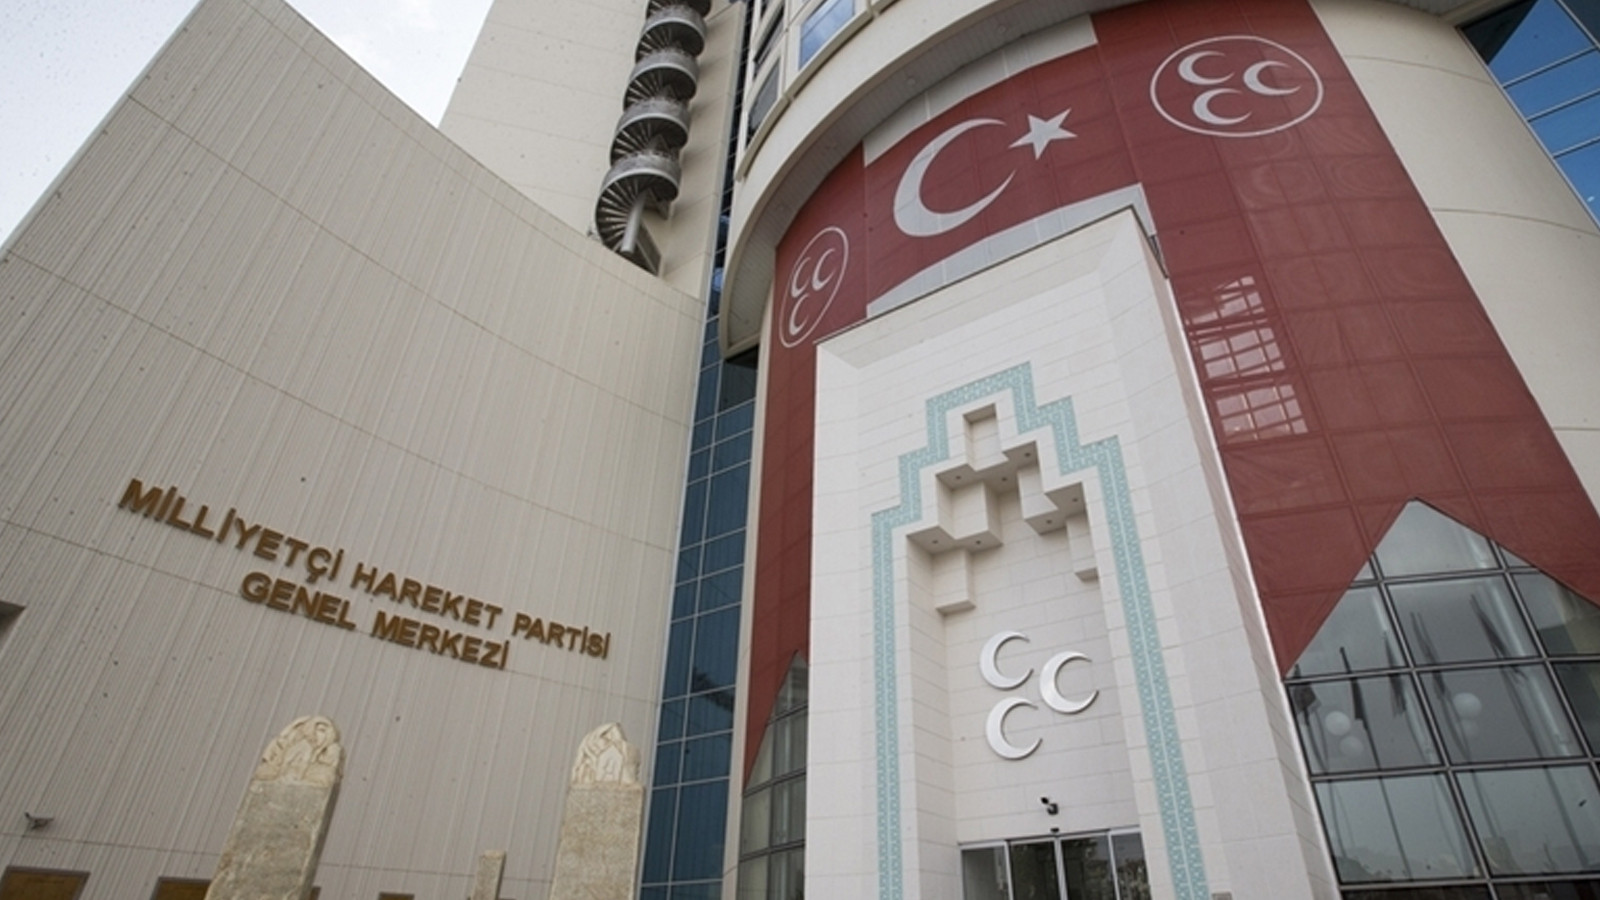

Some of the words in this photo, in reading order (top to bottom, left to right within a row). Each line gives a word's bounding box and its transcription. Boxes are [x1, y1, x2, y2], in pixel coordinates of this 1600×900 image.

[118, 478, 344, 584] MİLLİYETÇİ
[351, 562, 503, 630] HAREKET
[512, 613, 611, 660] PARTİSİ
[241, 571, 356, 631] GENEL
[370, 610, 510, 670] MERKEZİ
